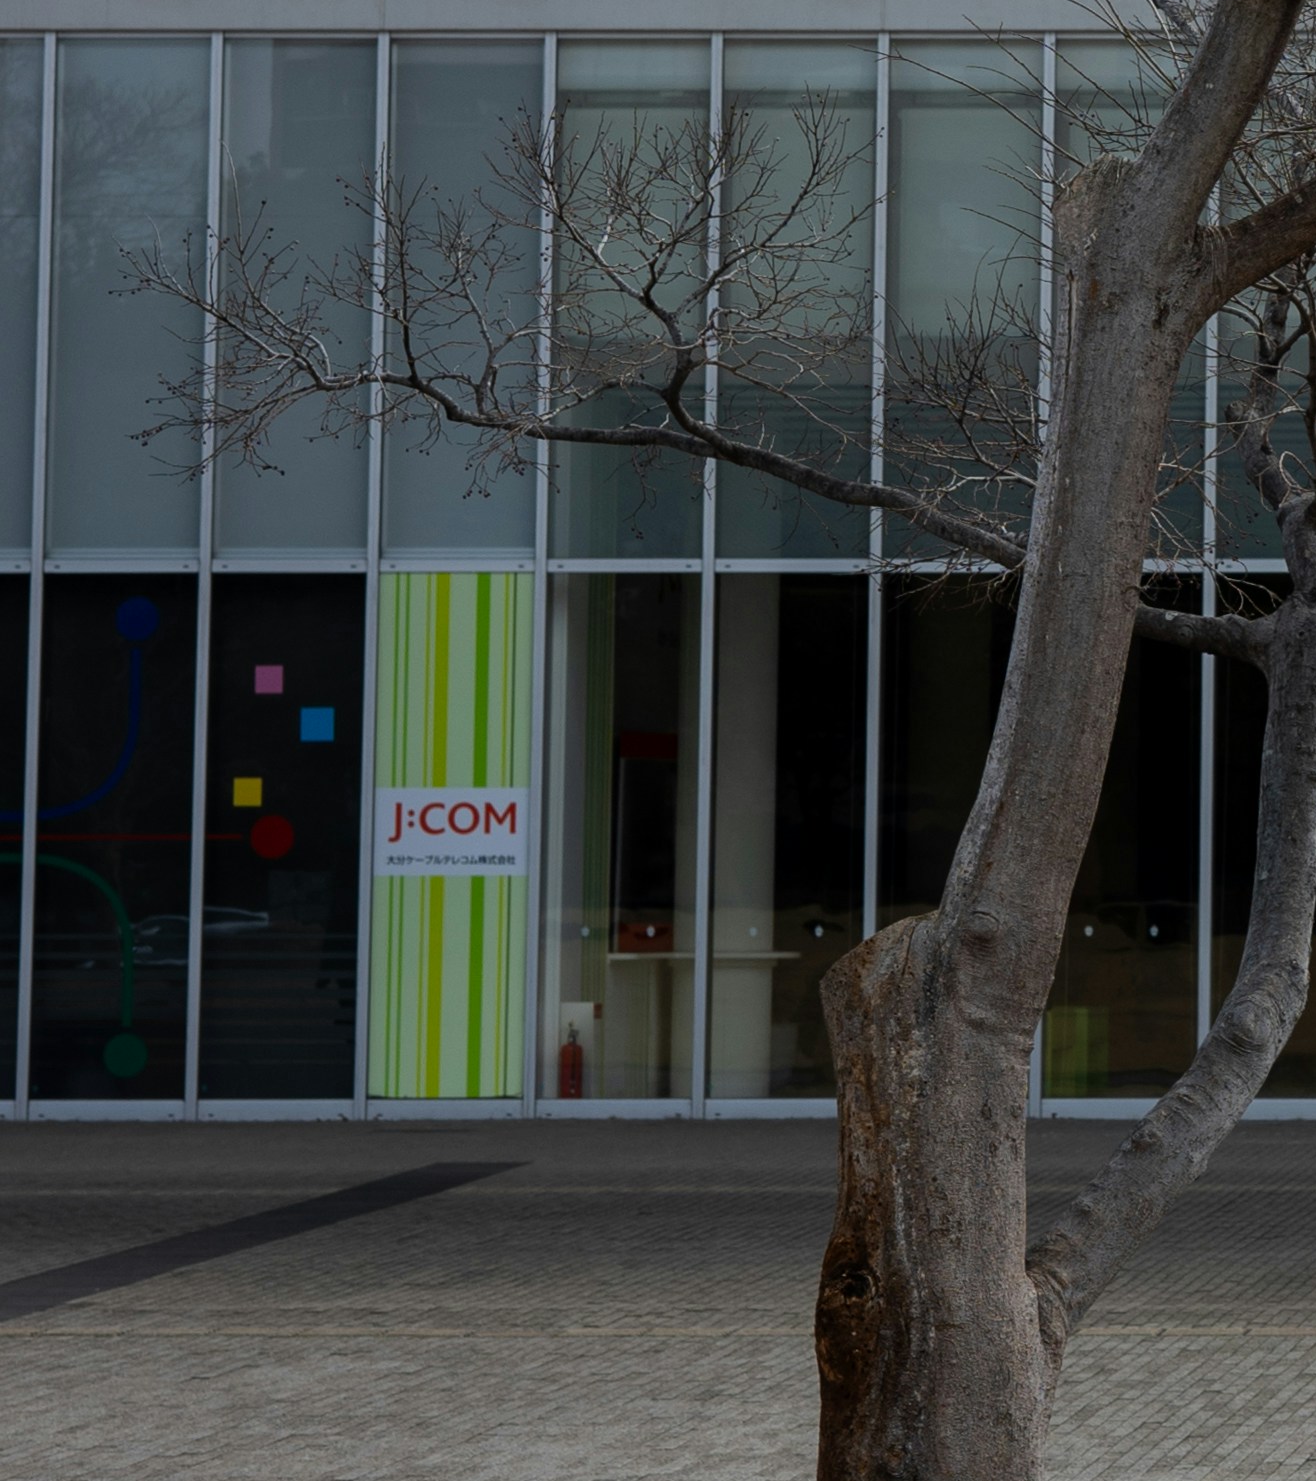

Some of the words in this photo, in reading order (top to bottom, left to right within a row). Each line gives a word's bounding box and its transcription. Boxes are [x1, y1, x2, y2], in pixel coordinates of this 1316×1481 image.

[388, 802, 517, 843] J:COM
[386, 854, 516, 866] 大分ケーブルテレコム株式会社
